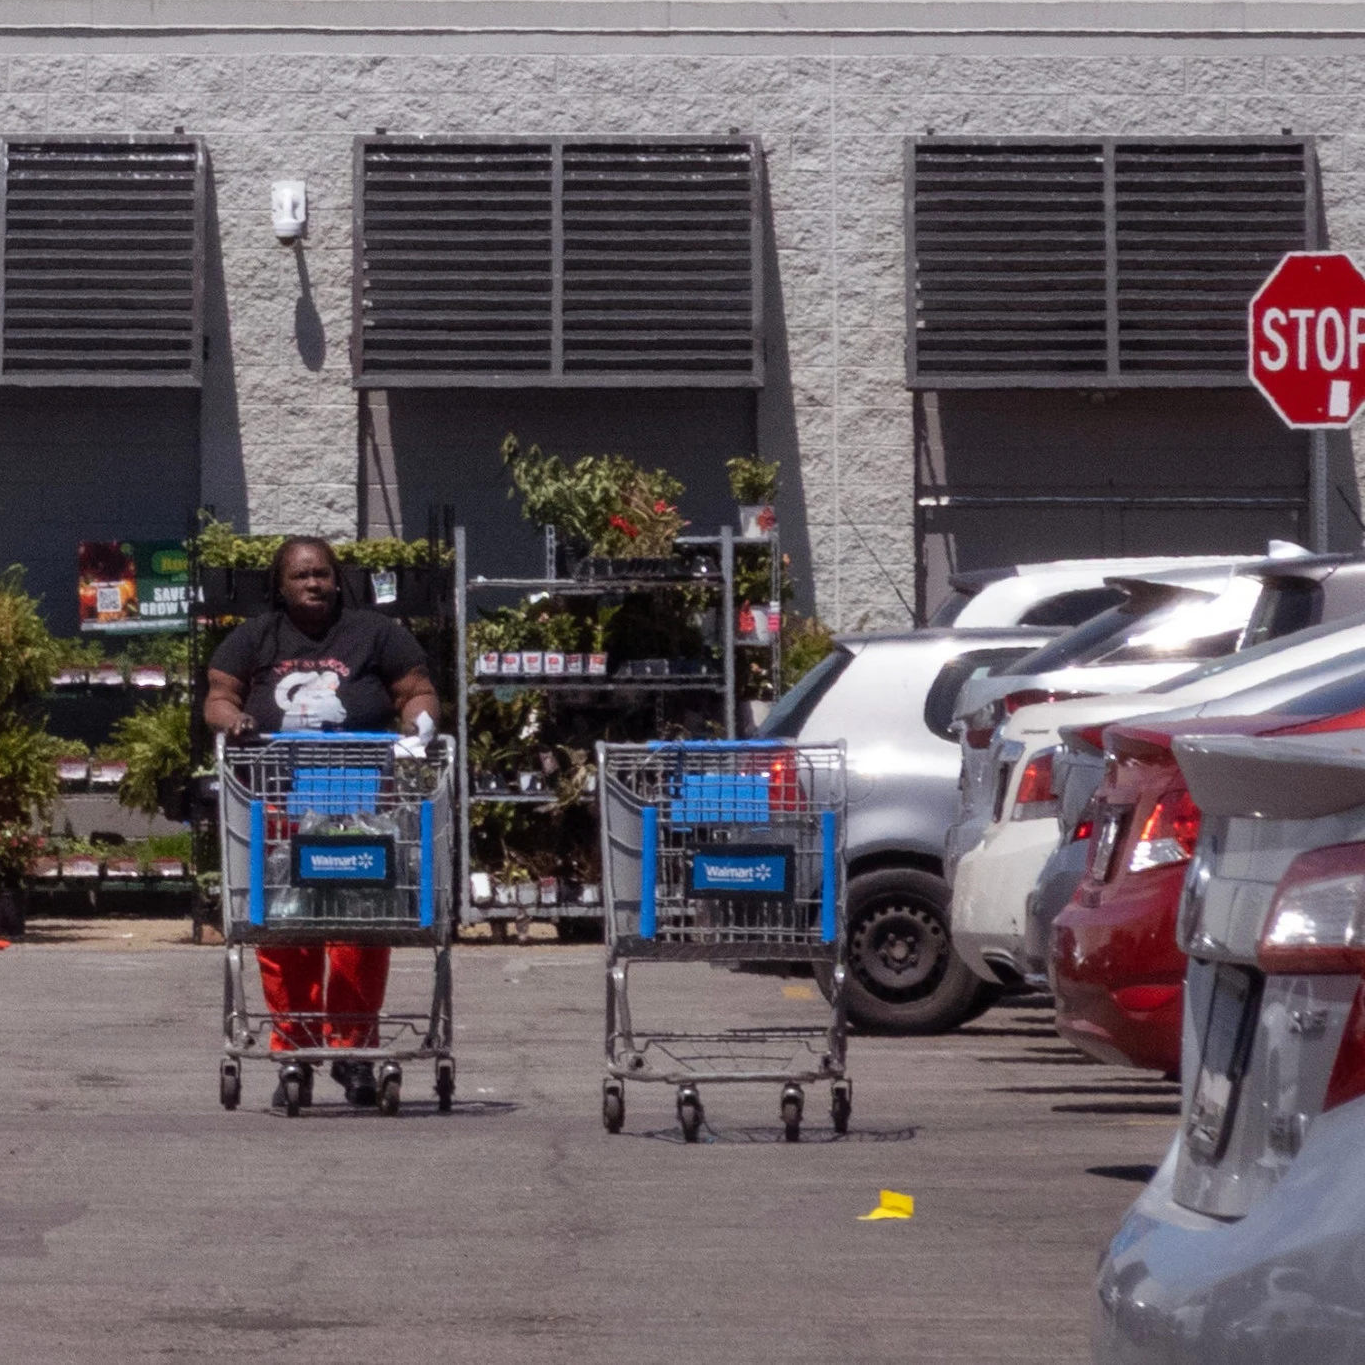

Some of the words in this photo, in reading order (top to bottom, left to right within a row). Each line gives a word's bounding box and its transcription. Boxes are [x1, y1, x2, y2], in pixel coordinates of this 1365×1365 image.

[1260, 307, 1365, 372] STOP
[153, 586, 186, 602] SAVE
[139, 602, 178, 616] GROW
[310, 855, 357, 867] Walmart
[706, 864, 754, 878] Walmart
